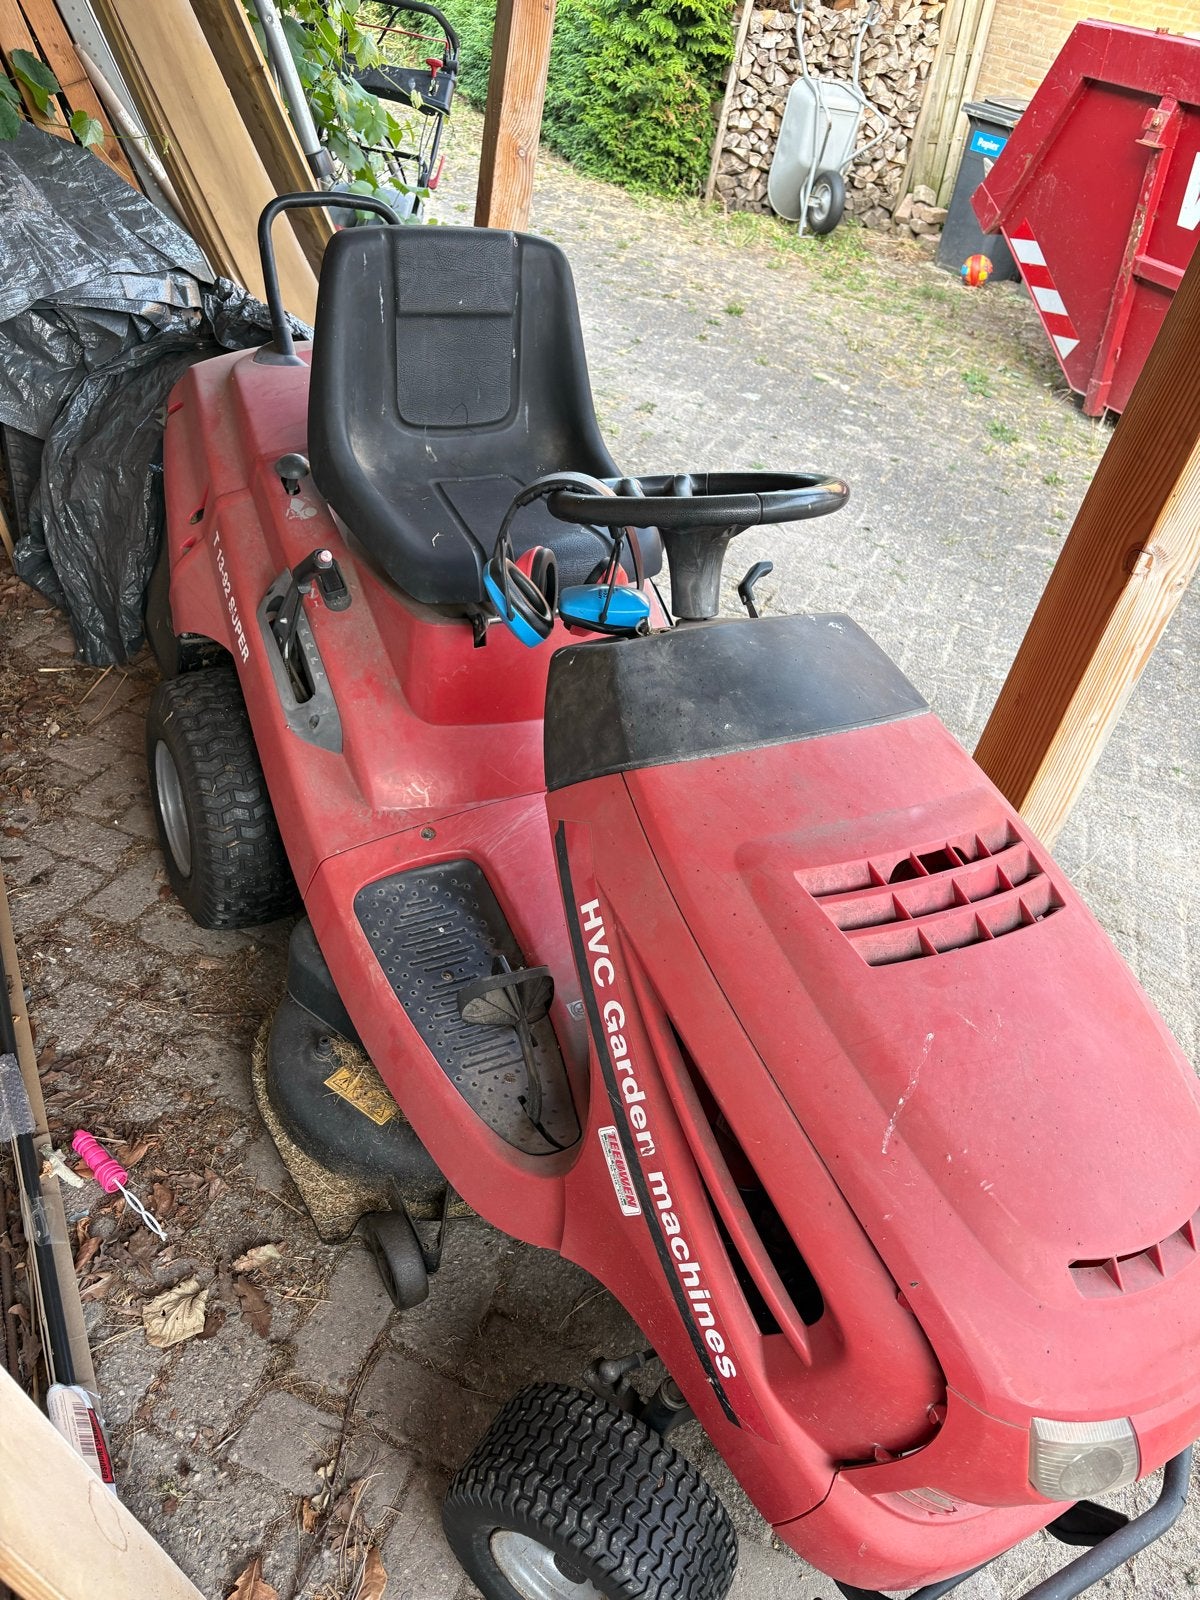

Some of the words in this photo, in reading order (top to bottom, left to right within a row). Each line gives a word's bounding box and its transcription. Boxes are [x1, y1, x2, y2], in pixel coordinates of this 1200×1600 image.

[213, 530, 220, 547] T
[228, 596, 249, 664] SUPER
[580, 898, 615, 988] HVC
[603, 1000, 656, 1157] Garden
[647, 1171, 737, 1379] machines
[607, 1133, 637, 1208] TEEUWEN
